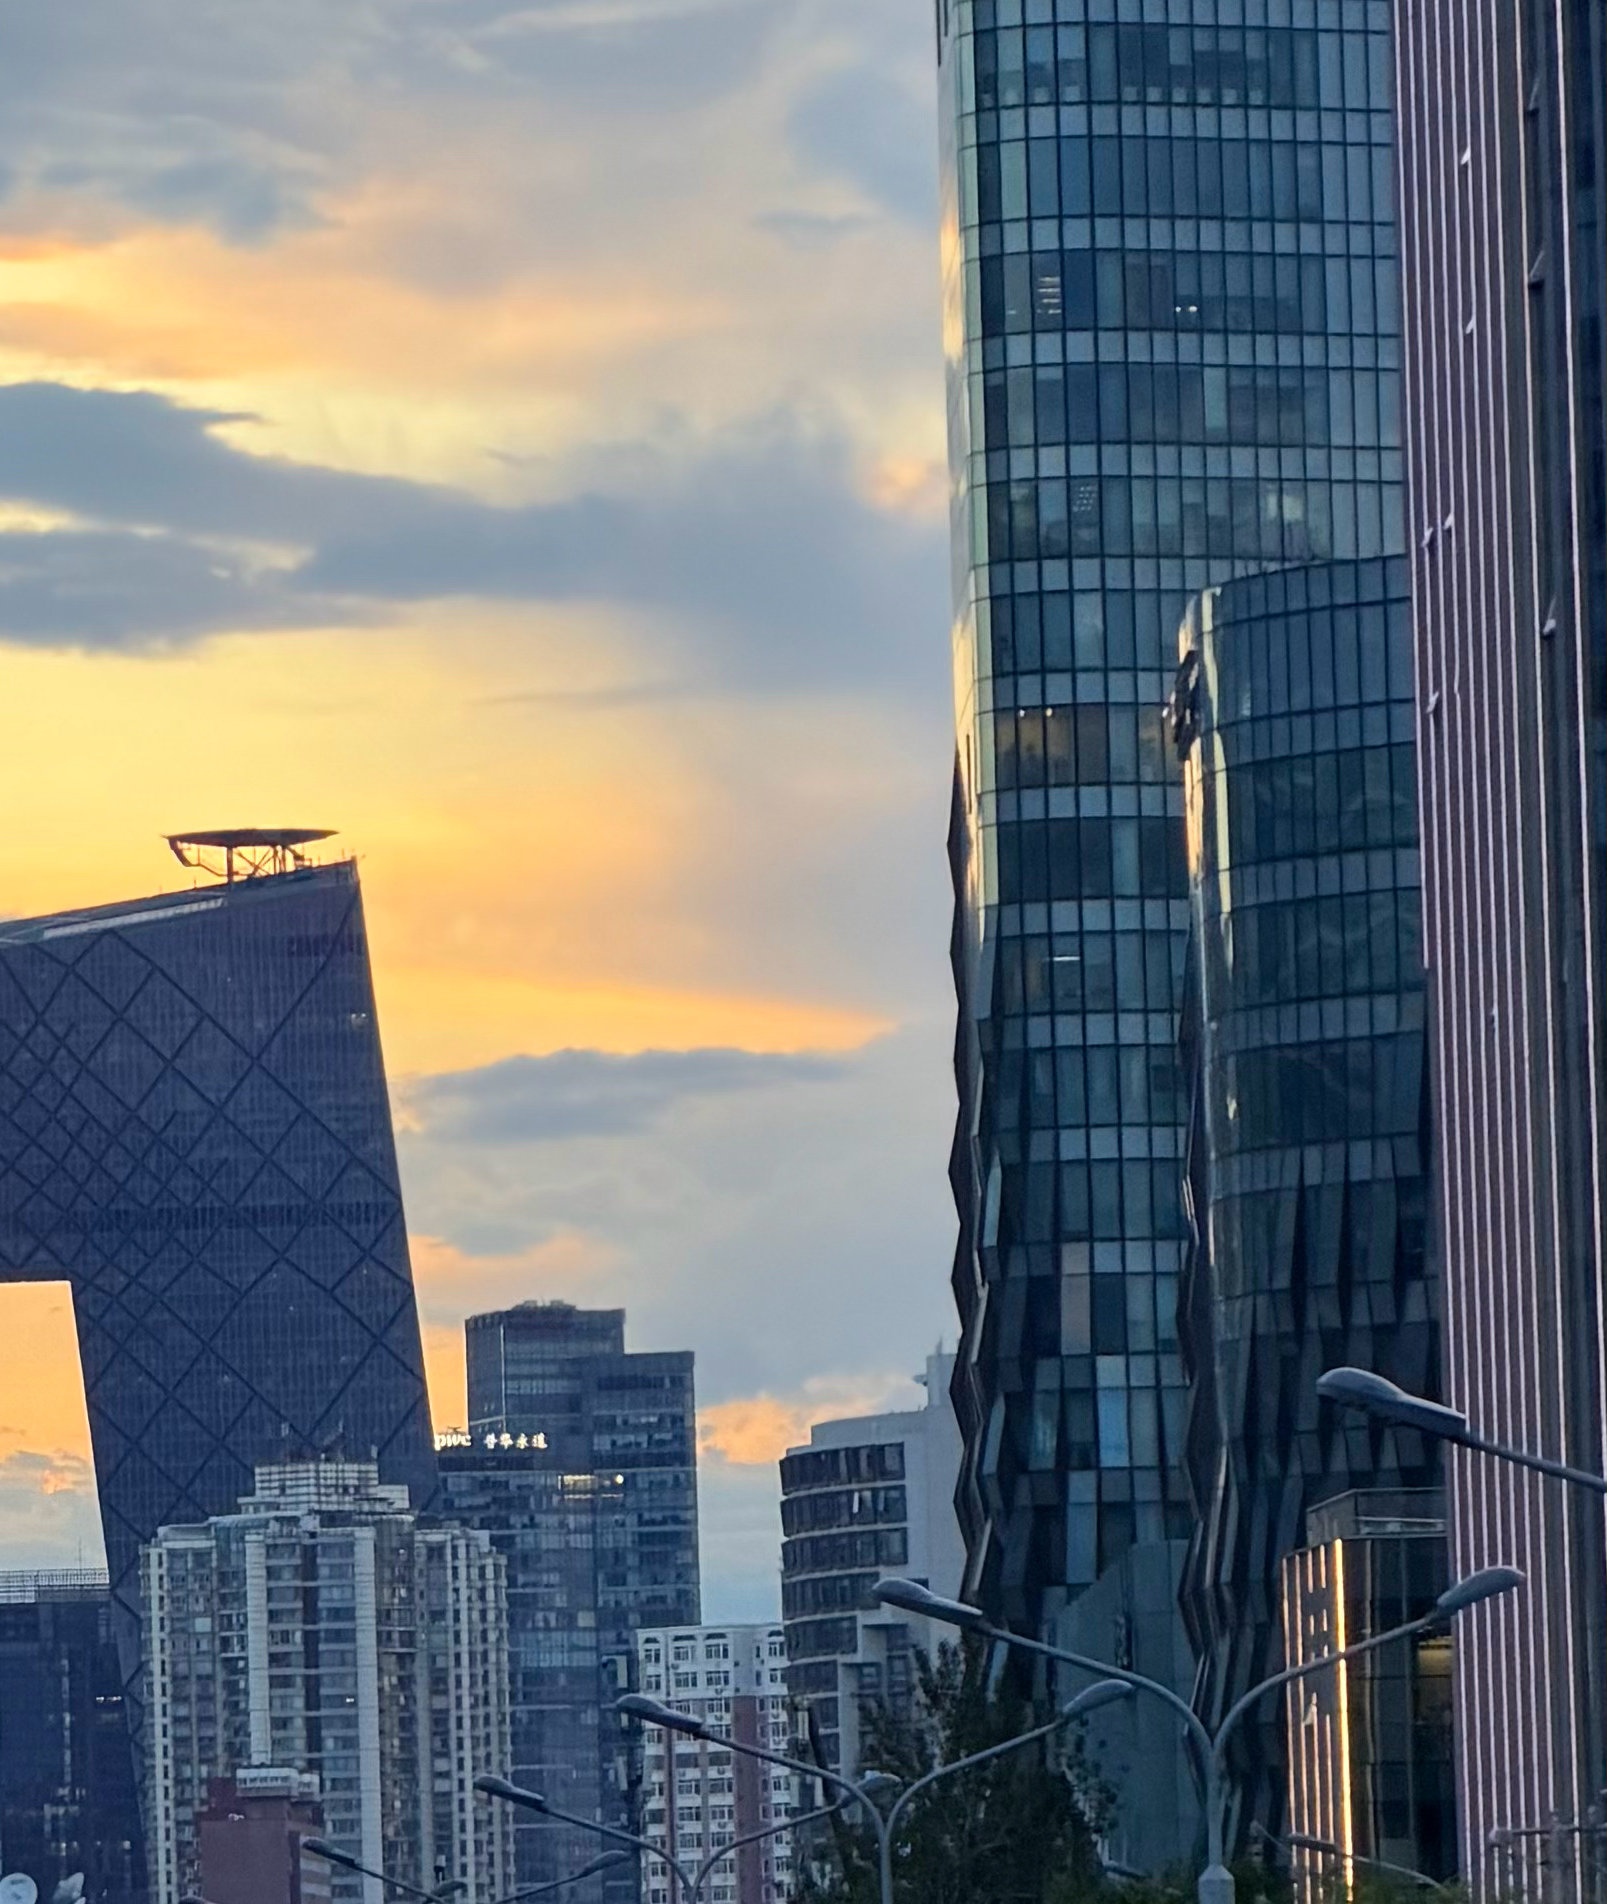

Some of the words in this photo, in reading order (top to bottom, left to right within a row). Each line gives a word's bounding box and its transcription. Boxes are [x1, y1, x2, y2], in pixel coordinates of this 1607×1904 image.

[433, 1433, 471, 1451] pwc
[483, 1432, 548, 1450] 普华永道
